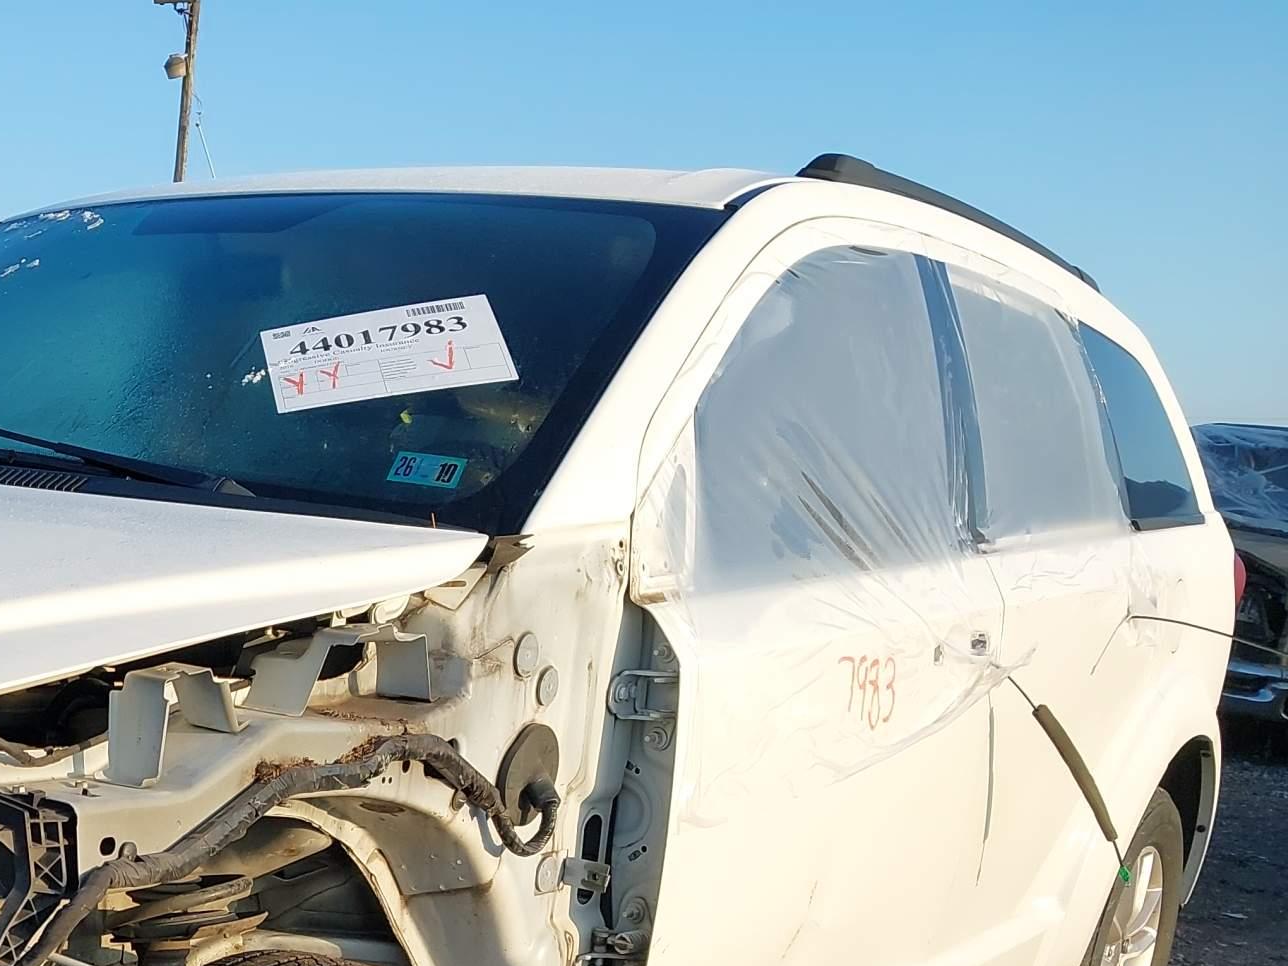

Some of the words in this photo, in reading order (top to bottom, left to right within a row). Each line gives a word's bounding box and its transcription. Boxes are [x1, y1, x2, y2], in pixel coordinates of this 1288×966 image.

[289, 316, 468, 356] 44017983
[376, 338, 420, 349] Insurance
[394, 456, 416, 477] 26
[838, 655, 896, 731] 7983
